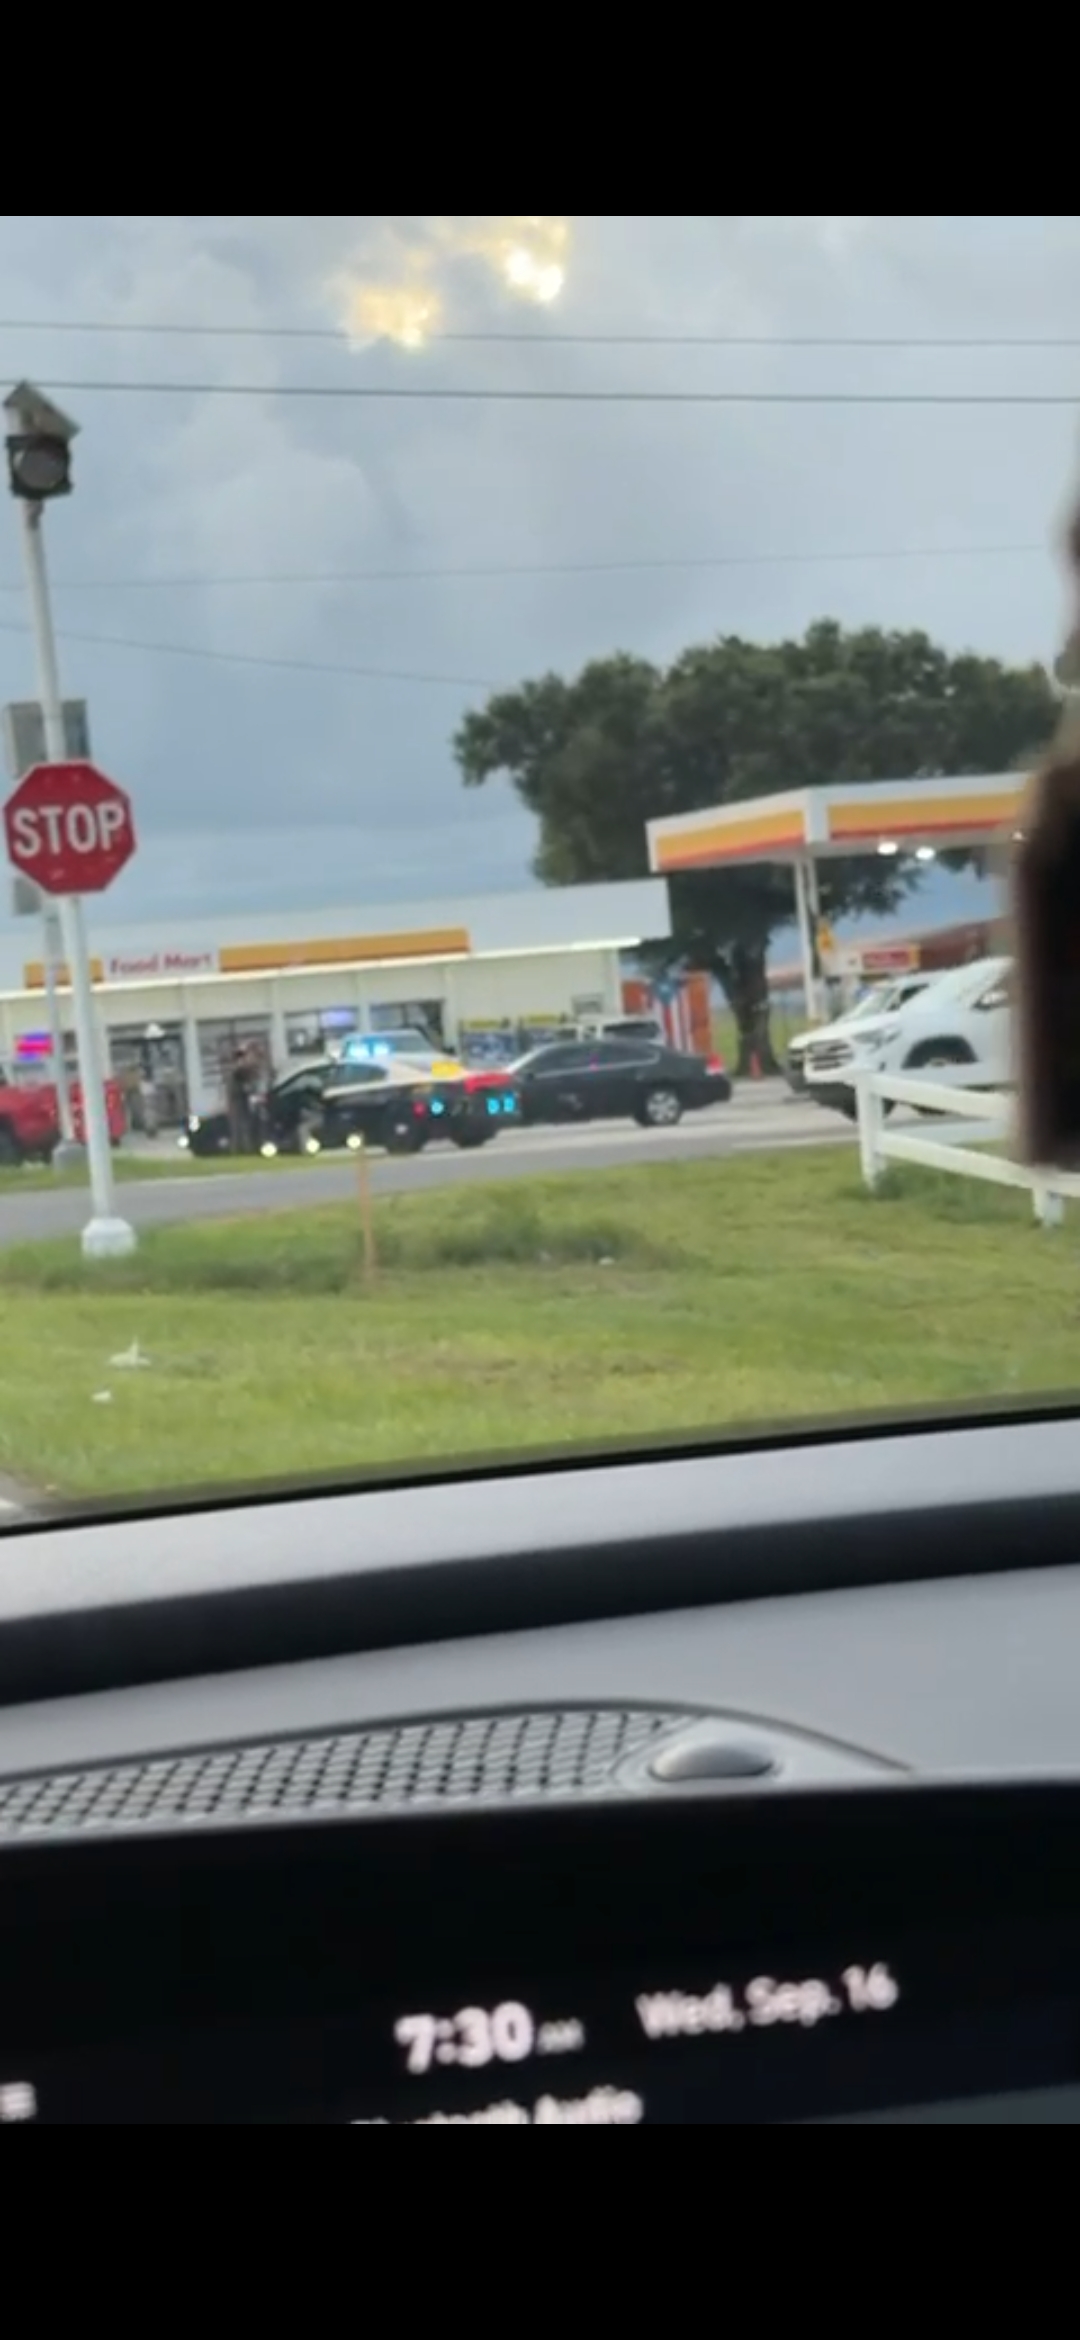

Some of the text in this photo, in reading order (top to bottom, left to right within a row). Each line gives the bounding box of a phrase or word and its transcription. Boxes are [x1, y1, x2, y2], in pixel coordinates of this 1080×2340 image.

[13, 802, 125, 858] STOP
[110, 952, 211, 974] Food Mart
[747, 1976, 841, 2027] Sep.
[843, 1962, 897, 2011] 16
[395, 2001, 533, 2074] 7:30
